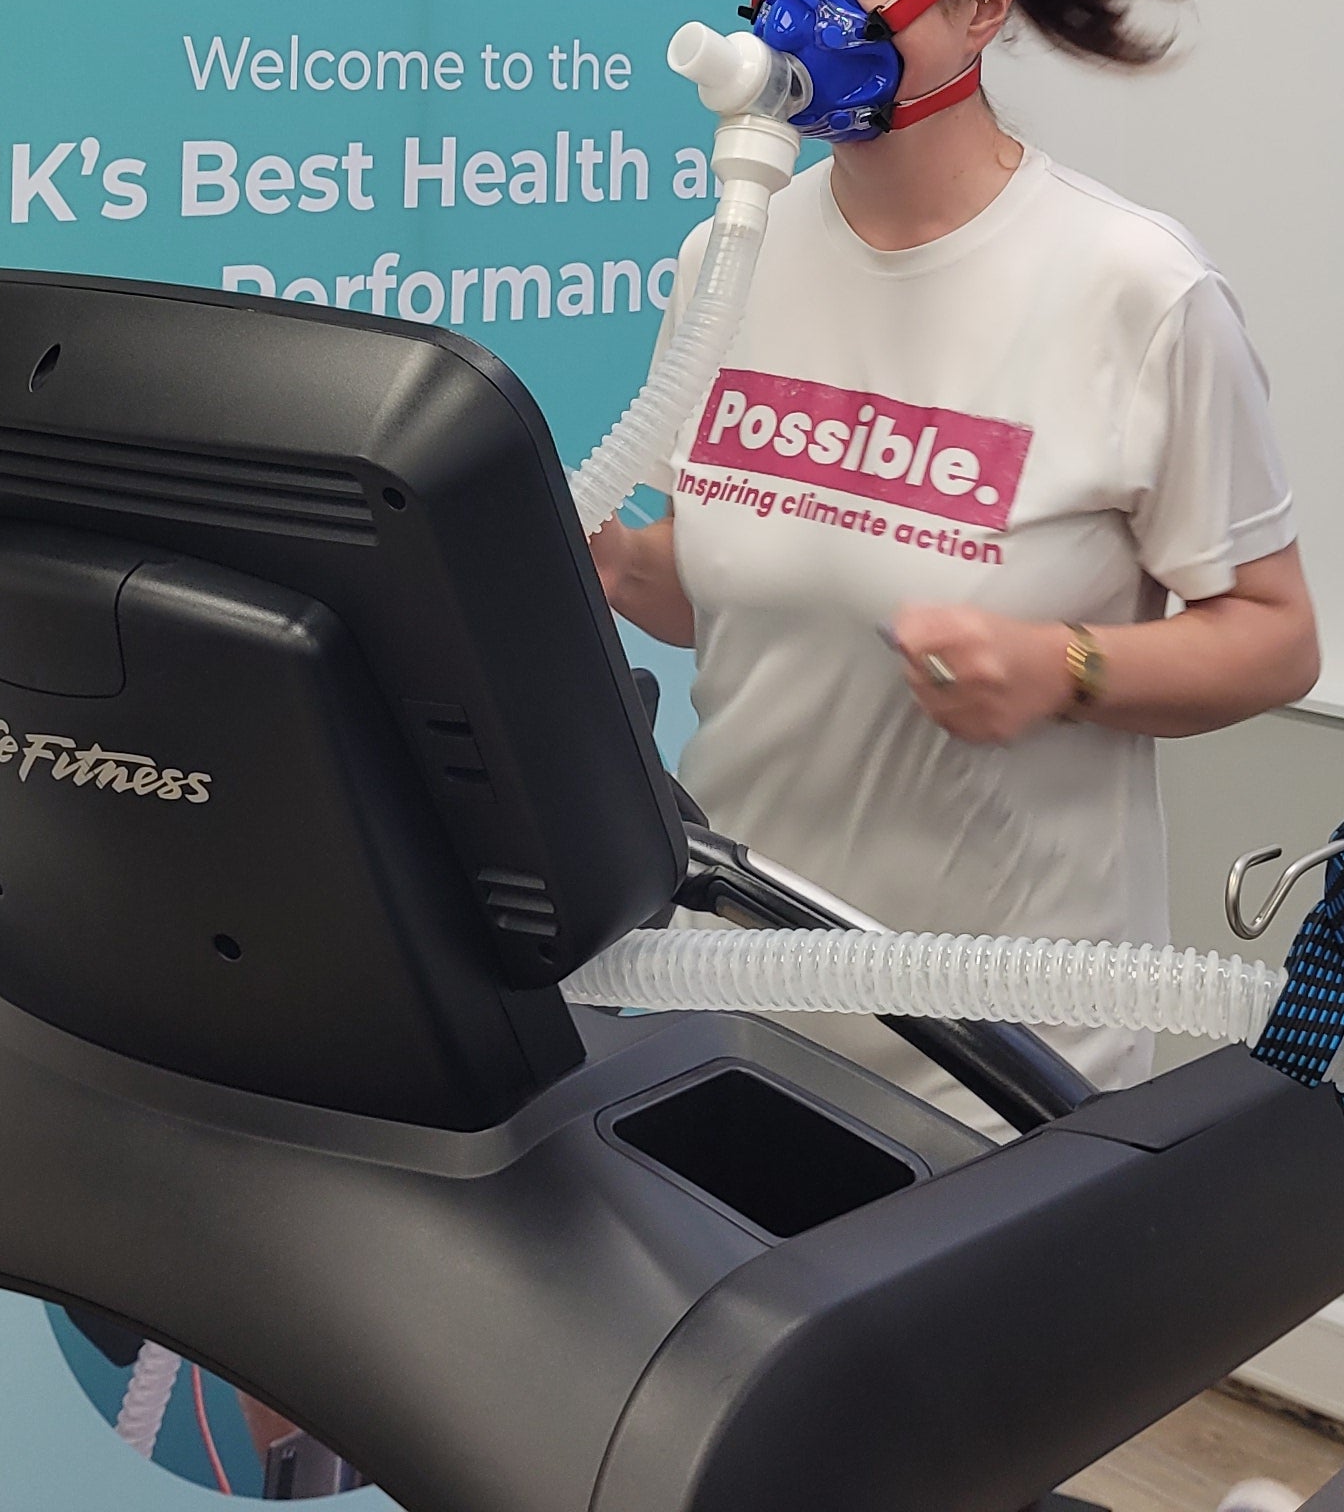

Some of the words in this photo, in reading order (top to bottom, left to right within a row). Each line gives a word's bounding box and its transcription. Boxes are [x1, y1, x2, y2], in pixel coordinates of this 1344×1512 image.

[182, 35, 464, 91] Welcome
[482, 43, 533, 91] to
[548, 38, 632, 90] the
[180, 139, 375, 218] Best
[403, 130, 650, 208] Health
[672, 147, 722, 199] a
[707, 390, 1000, 506] Possible.
[676, 468, 778, 518] Inspiring
[781, 491, 886, 537] climate
[894, 521, 1004, 565] action
[16, 733, 212, 804] Fitness
